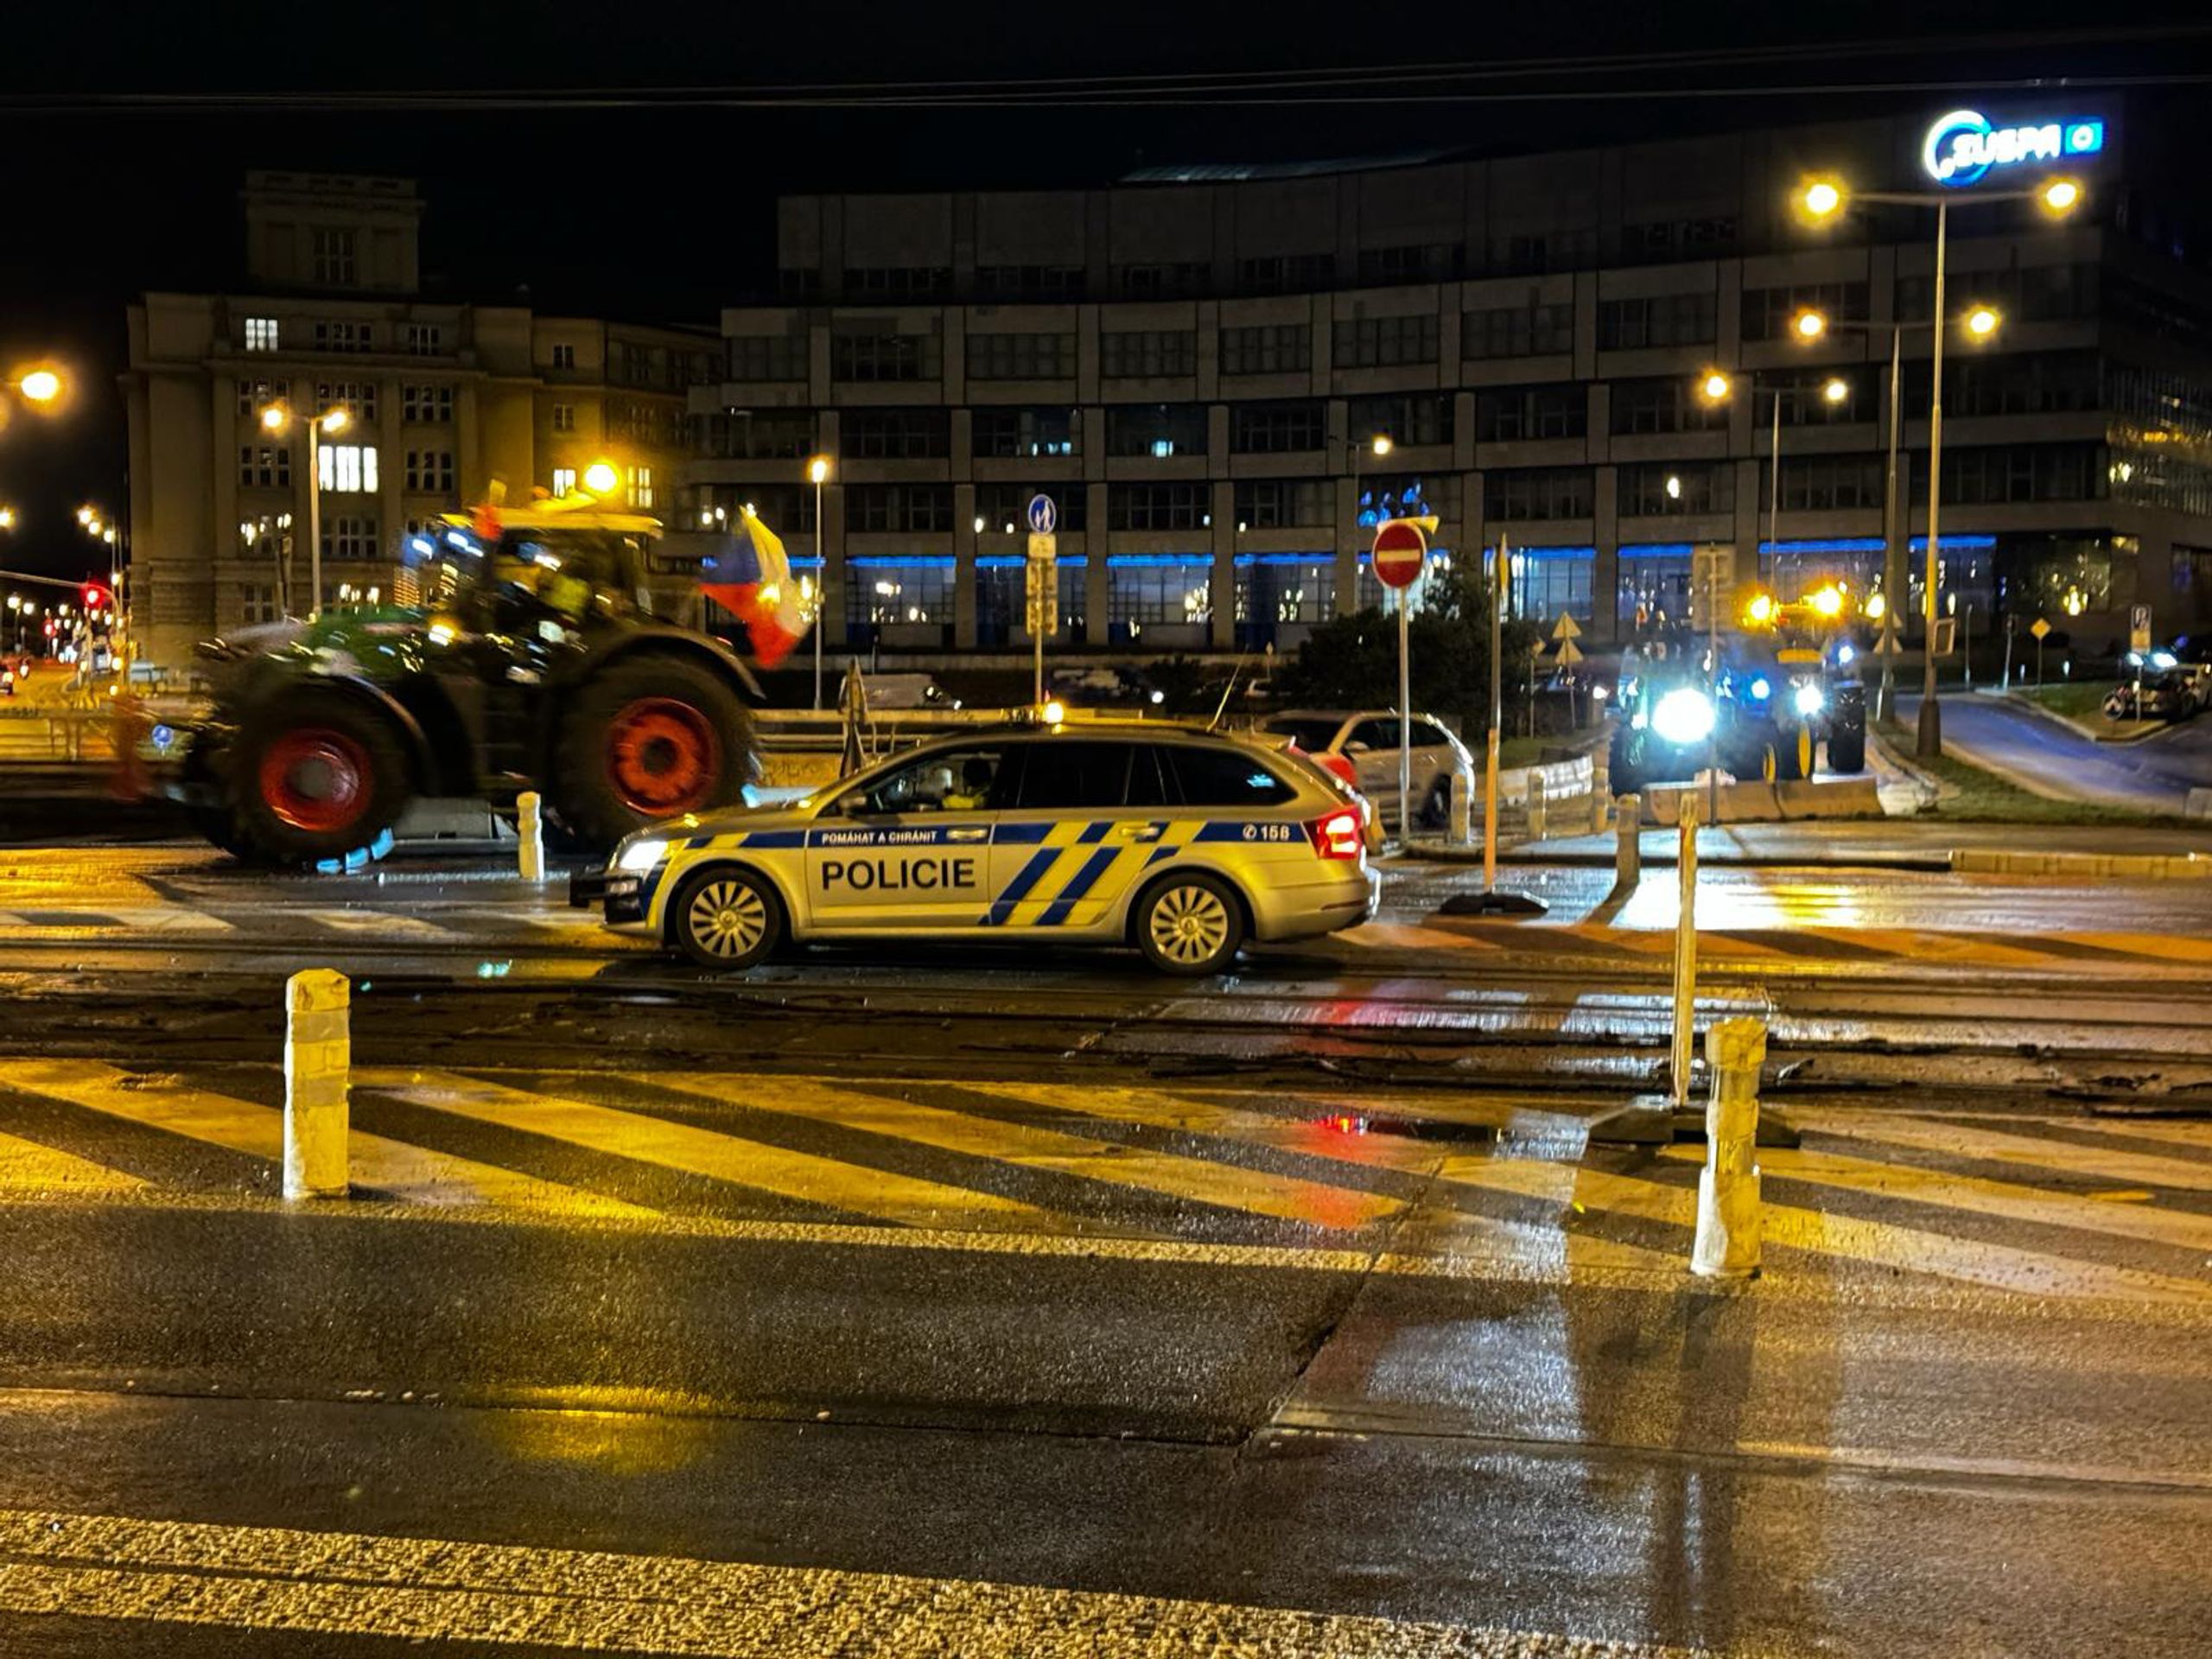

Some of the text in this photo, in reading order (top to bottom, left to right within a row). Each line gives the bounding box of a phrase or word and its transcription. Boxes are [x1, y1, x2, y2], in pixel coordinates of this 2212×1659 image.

[822, 829, 937, 844] POMÁHAT A CHRÁNIT
[1261, 824, 1290, 841] 158
[822, 858, 976, 891] POLICIE
